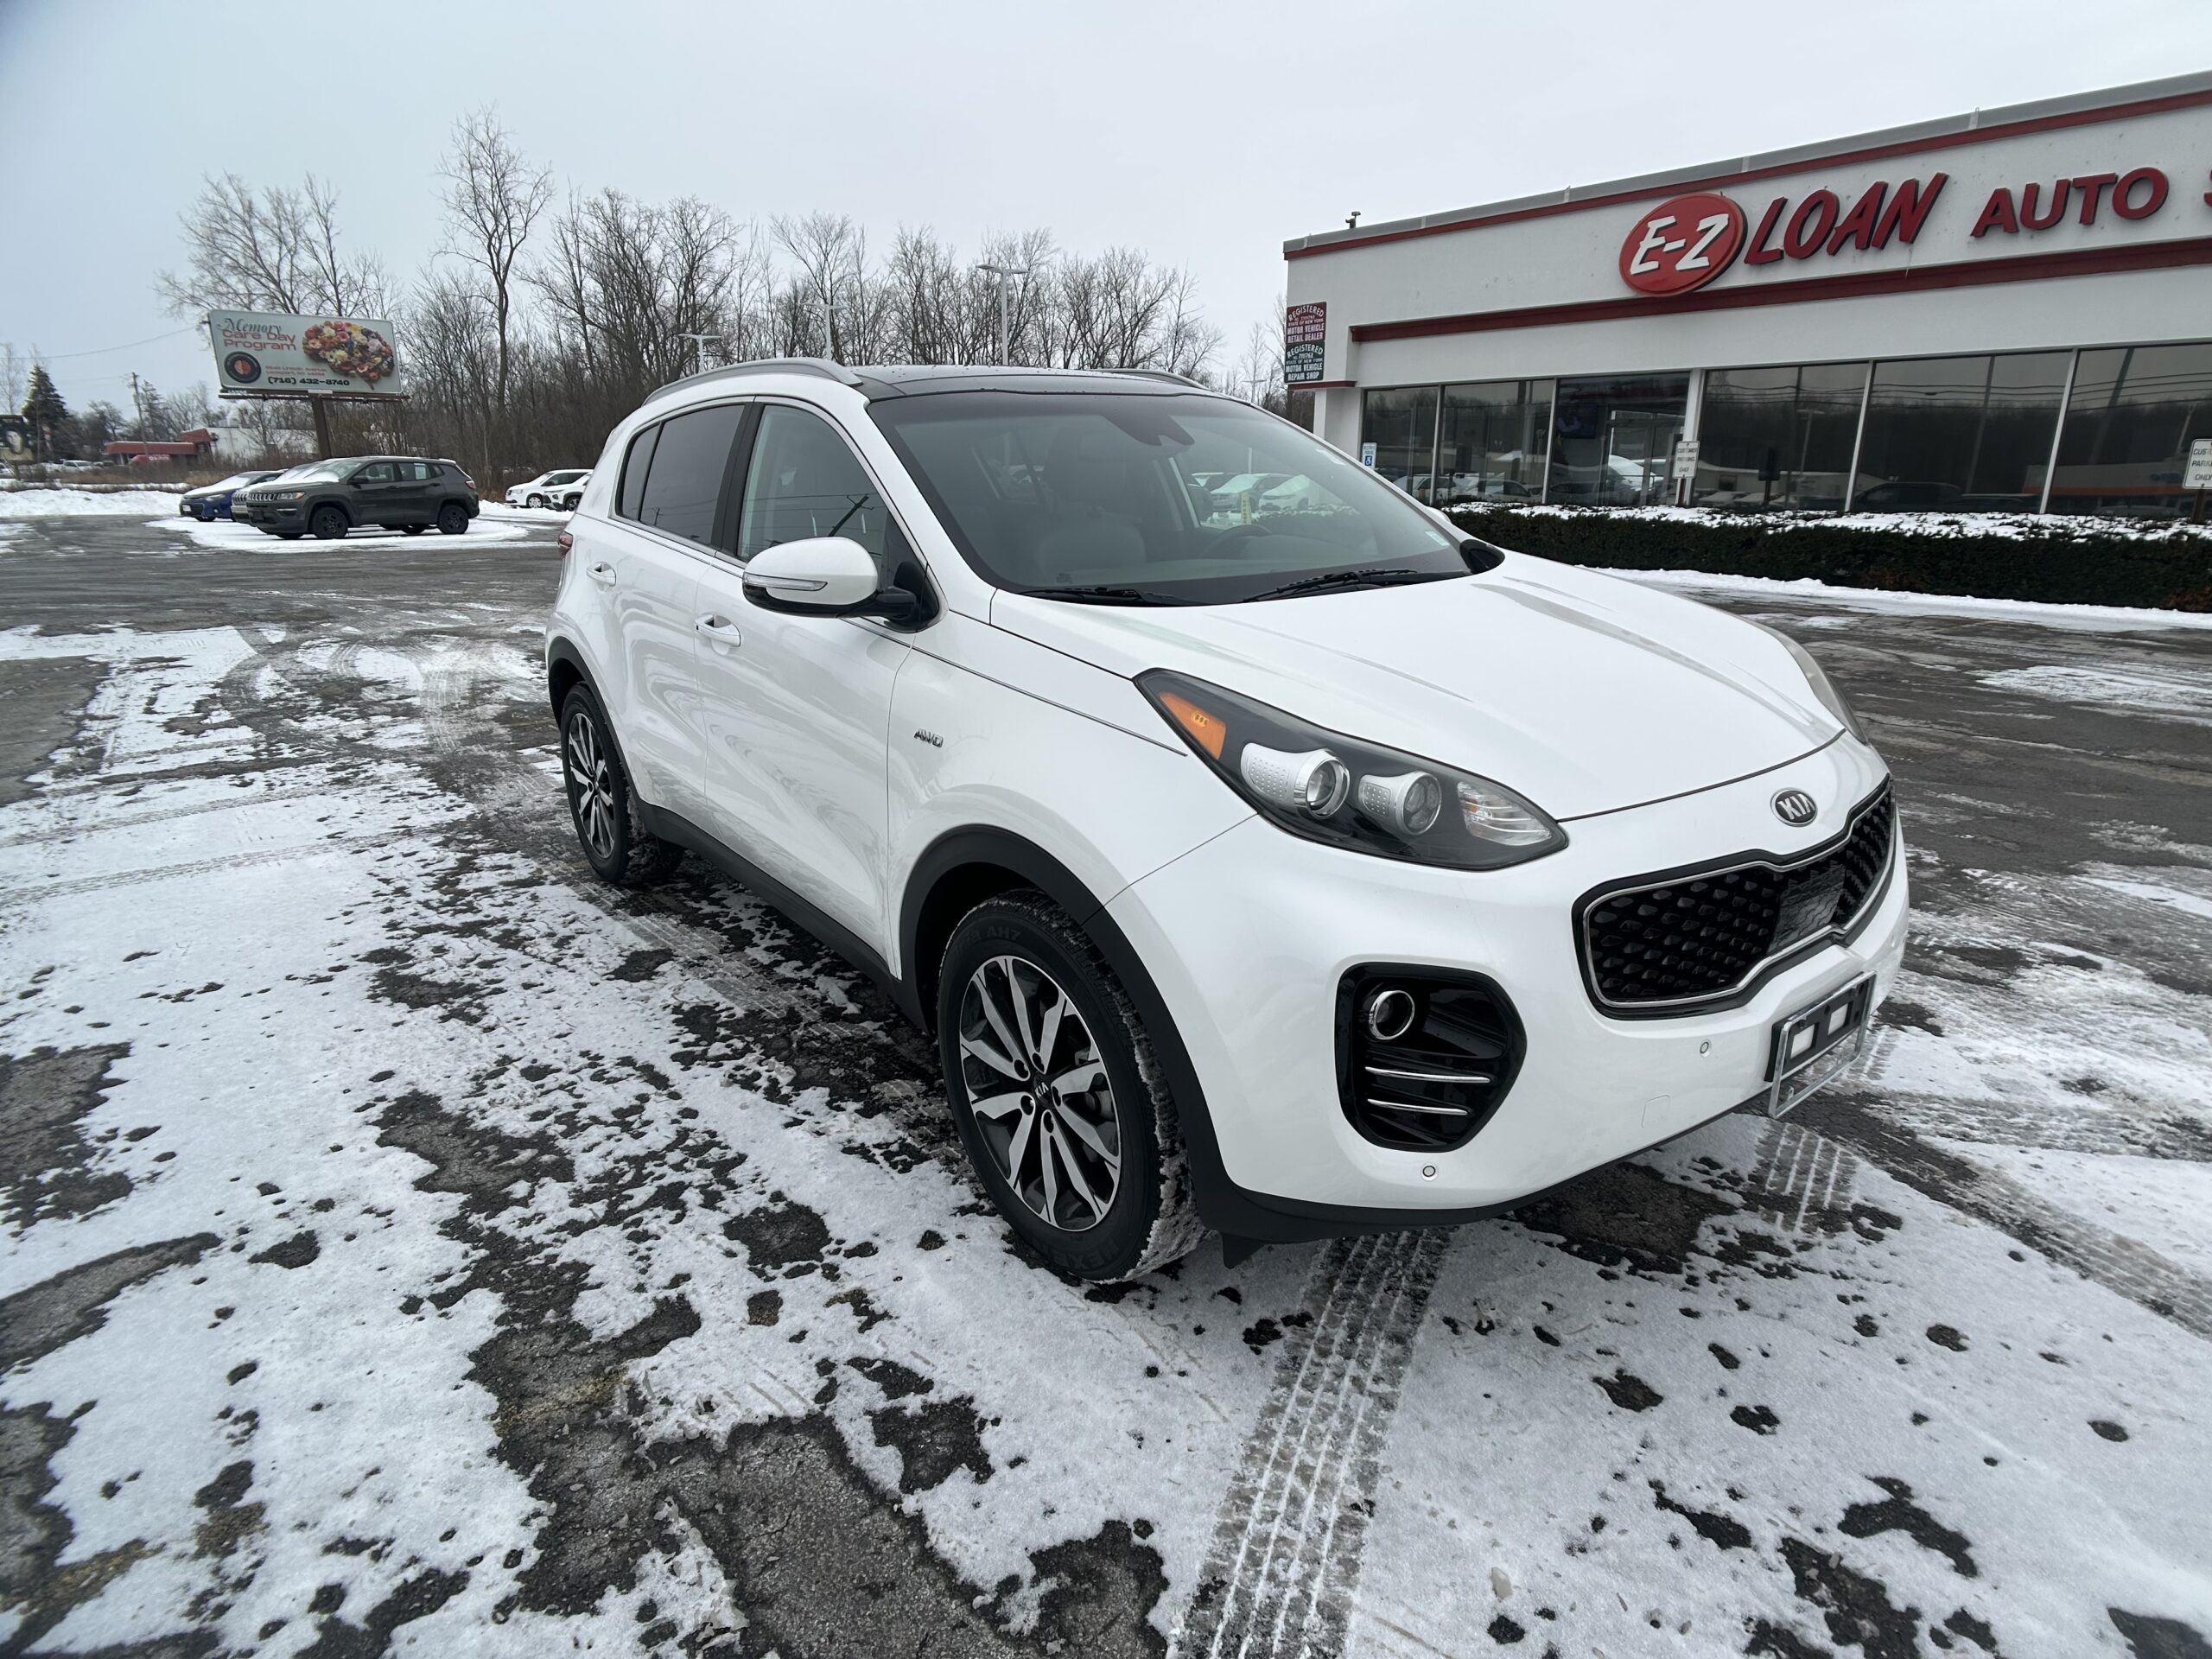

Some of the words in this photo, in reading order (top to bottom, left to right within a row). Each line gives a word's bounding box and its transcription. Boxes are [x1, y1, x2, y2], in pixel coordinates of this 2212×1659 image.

[1630, 213, 1729, 276] E-Z
[1744, 172, 1948, 265] LOAN
[1970, 167, 2169, 238] AUTO
[1288, 305, 1324, 321] REGISTERED
[218, 318, 282, 334] Memory
[1287, 326, 1303, 335] MOTOR
[1305, 323, 1324, 333] VEHICLE
[222, 329, 261, 339] Care
[267, 332, 296, 344] Day
[1287, 334, 1304, 343] RETAIL
[1305, 332, 1323, 340] DEALER
[224, 339, 296, 351] Program
[1287, 344, 1323, 359] REGISTERED
[1304, 363, 1322, 372] VEHICLE
[914, 728, 944, 748] AWD
[1777, 793, 1815, 820] KIA
[1034, 1082, 1049, 1099] KIA
